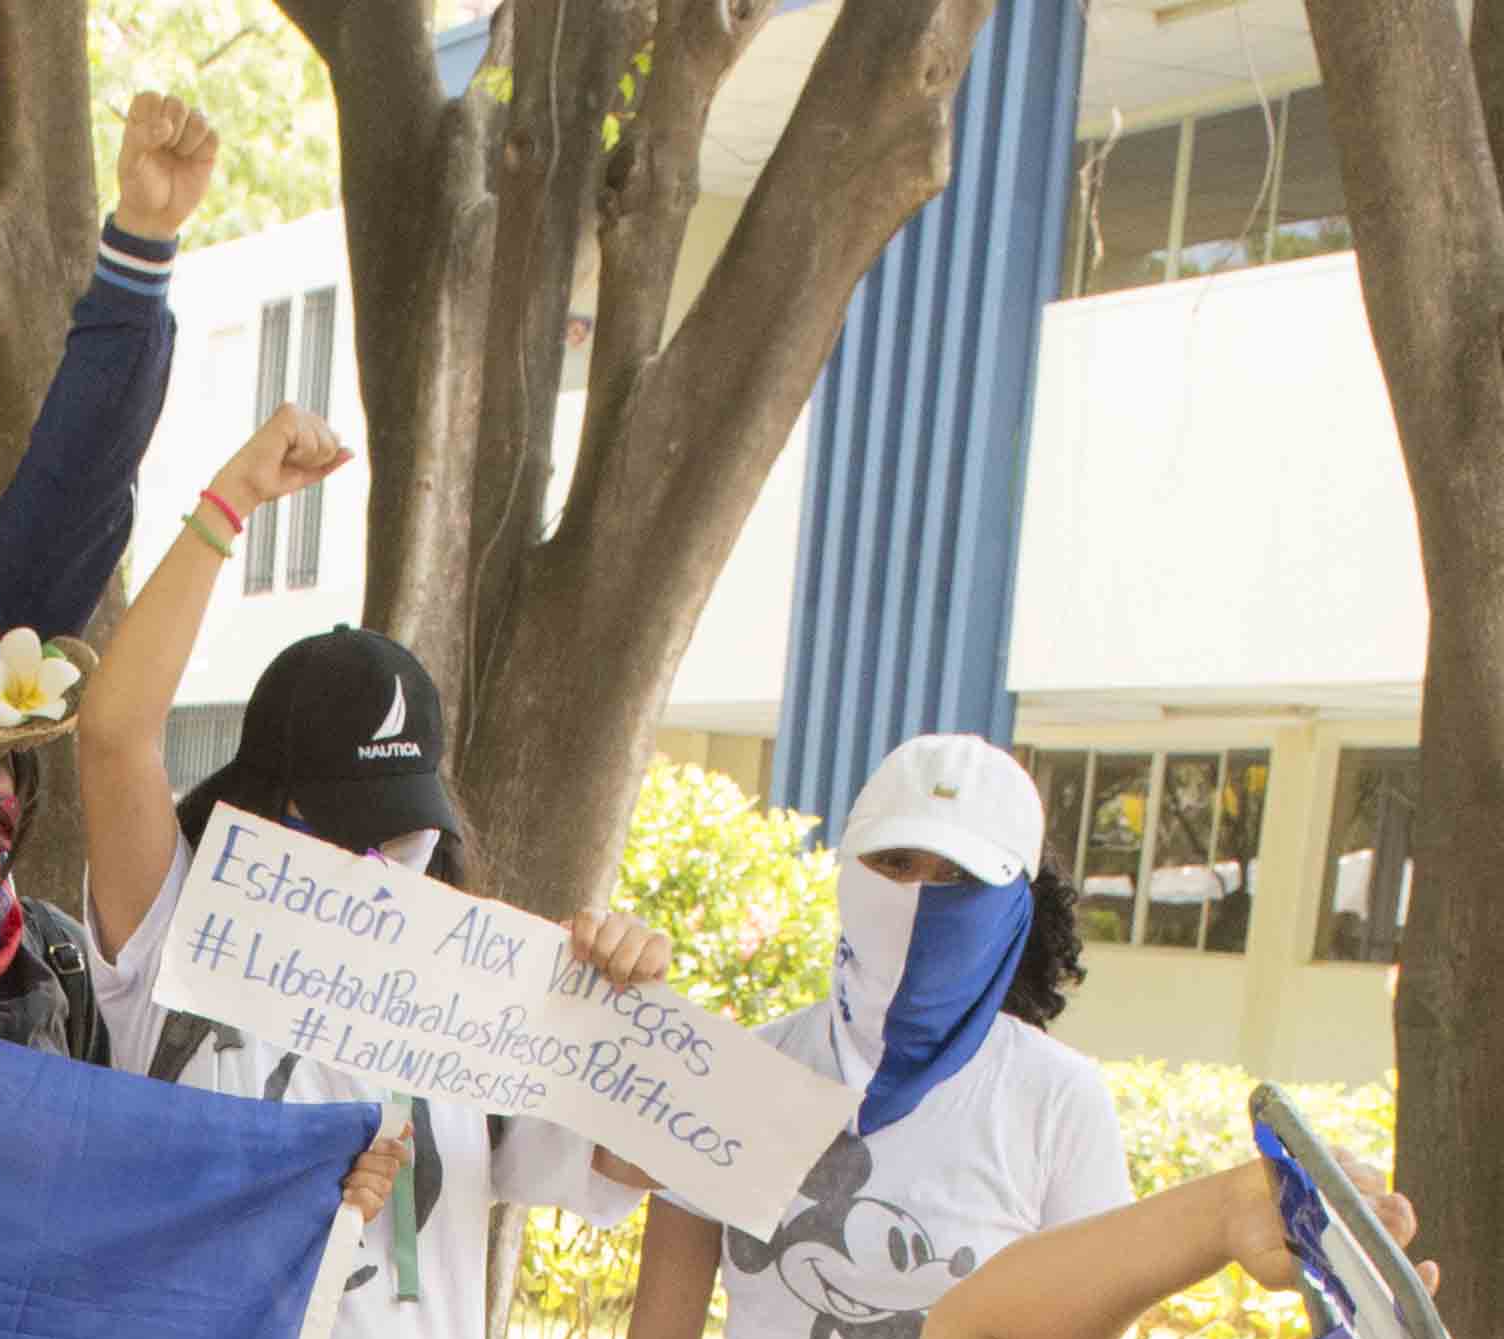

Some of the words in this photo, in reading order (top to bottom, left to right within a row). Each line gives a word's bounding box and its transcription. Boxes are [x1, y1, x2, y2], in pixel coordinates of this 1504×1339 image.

[358, 742, 422, 759] NAUTICA
[212, 824, 406, 945] Estación
[434, 905, 527, 981] Alex
